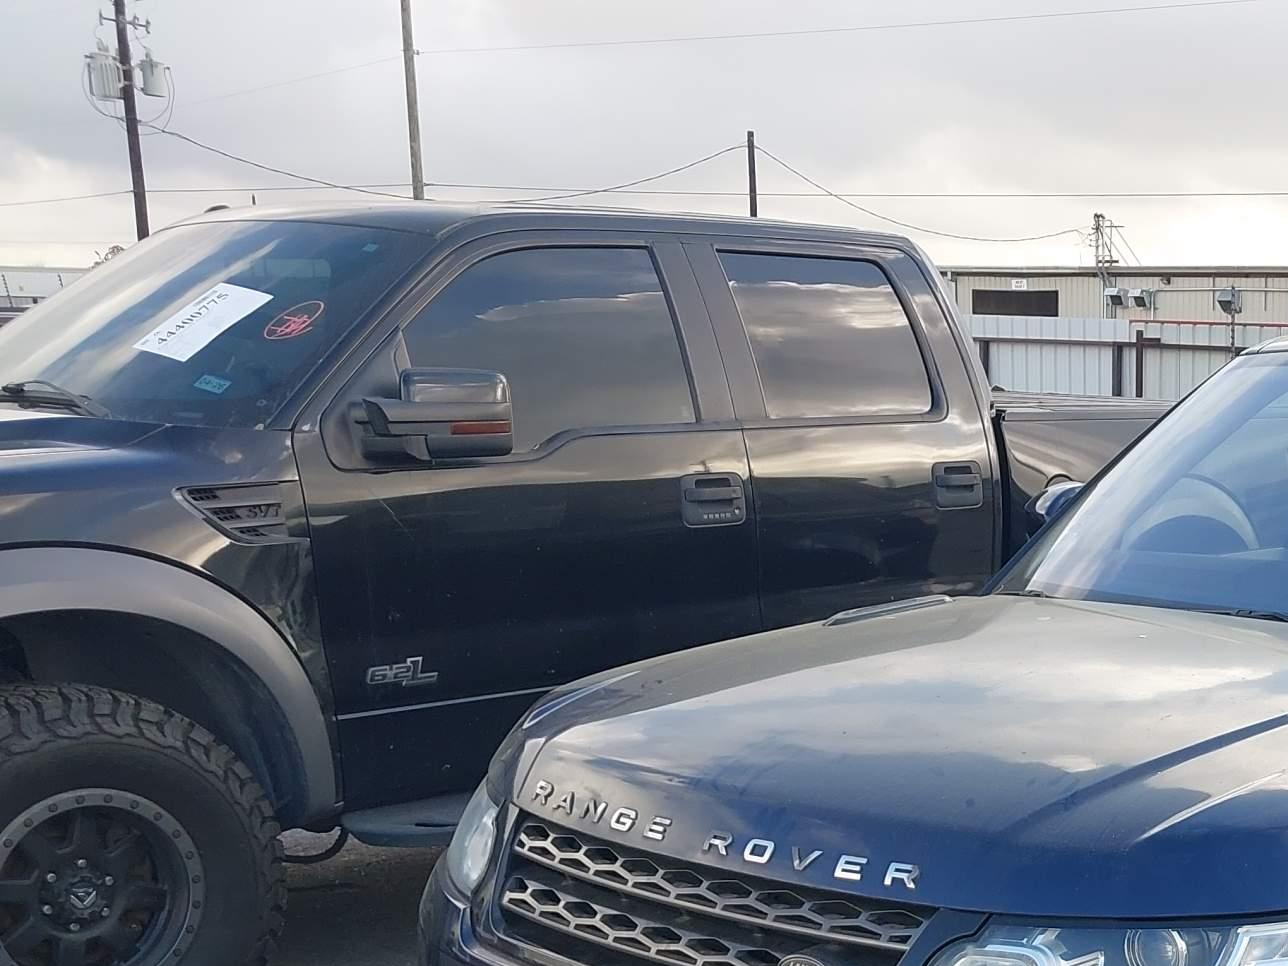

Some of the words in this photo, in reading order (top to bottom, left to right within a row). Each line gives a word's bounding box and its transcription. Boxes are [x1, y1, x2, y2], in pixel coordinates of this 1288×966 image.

[156, 292, 230, 346] 44400775
[246, 504, 282, 519] SVT
[532, 779, 673, 841] RANGE
[703, 829, 921, 889] ROVER
